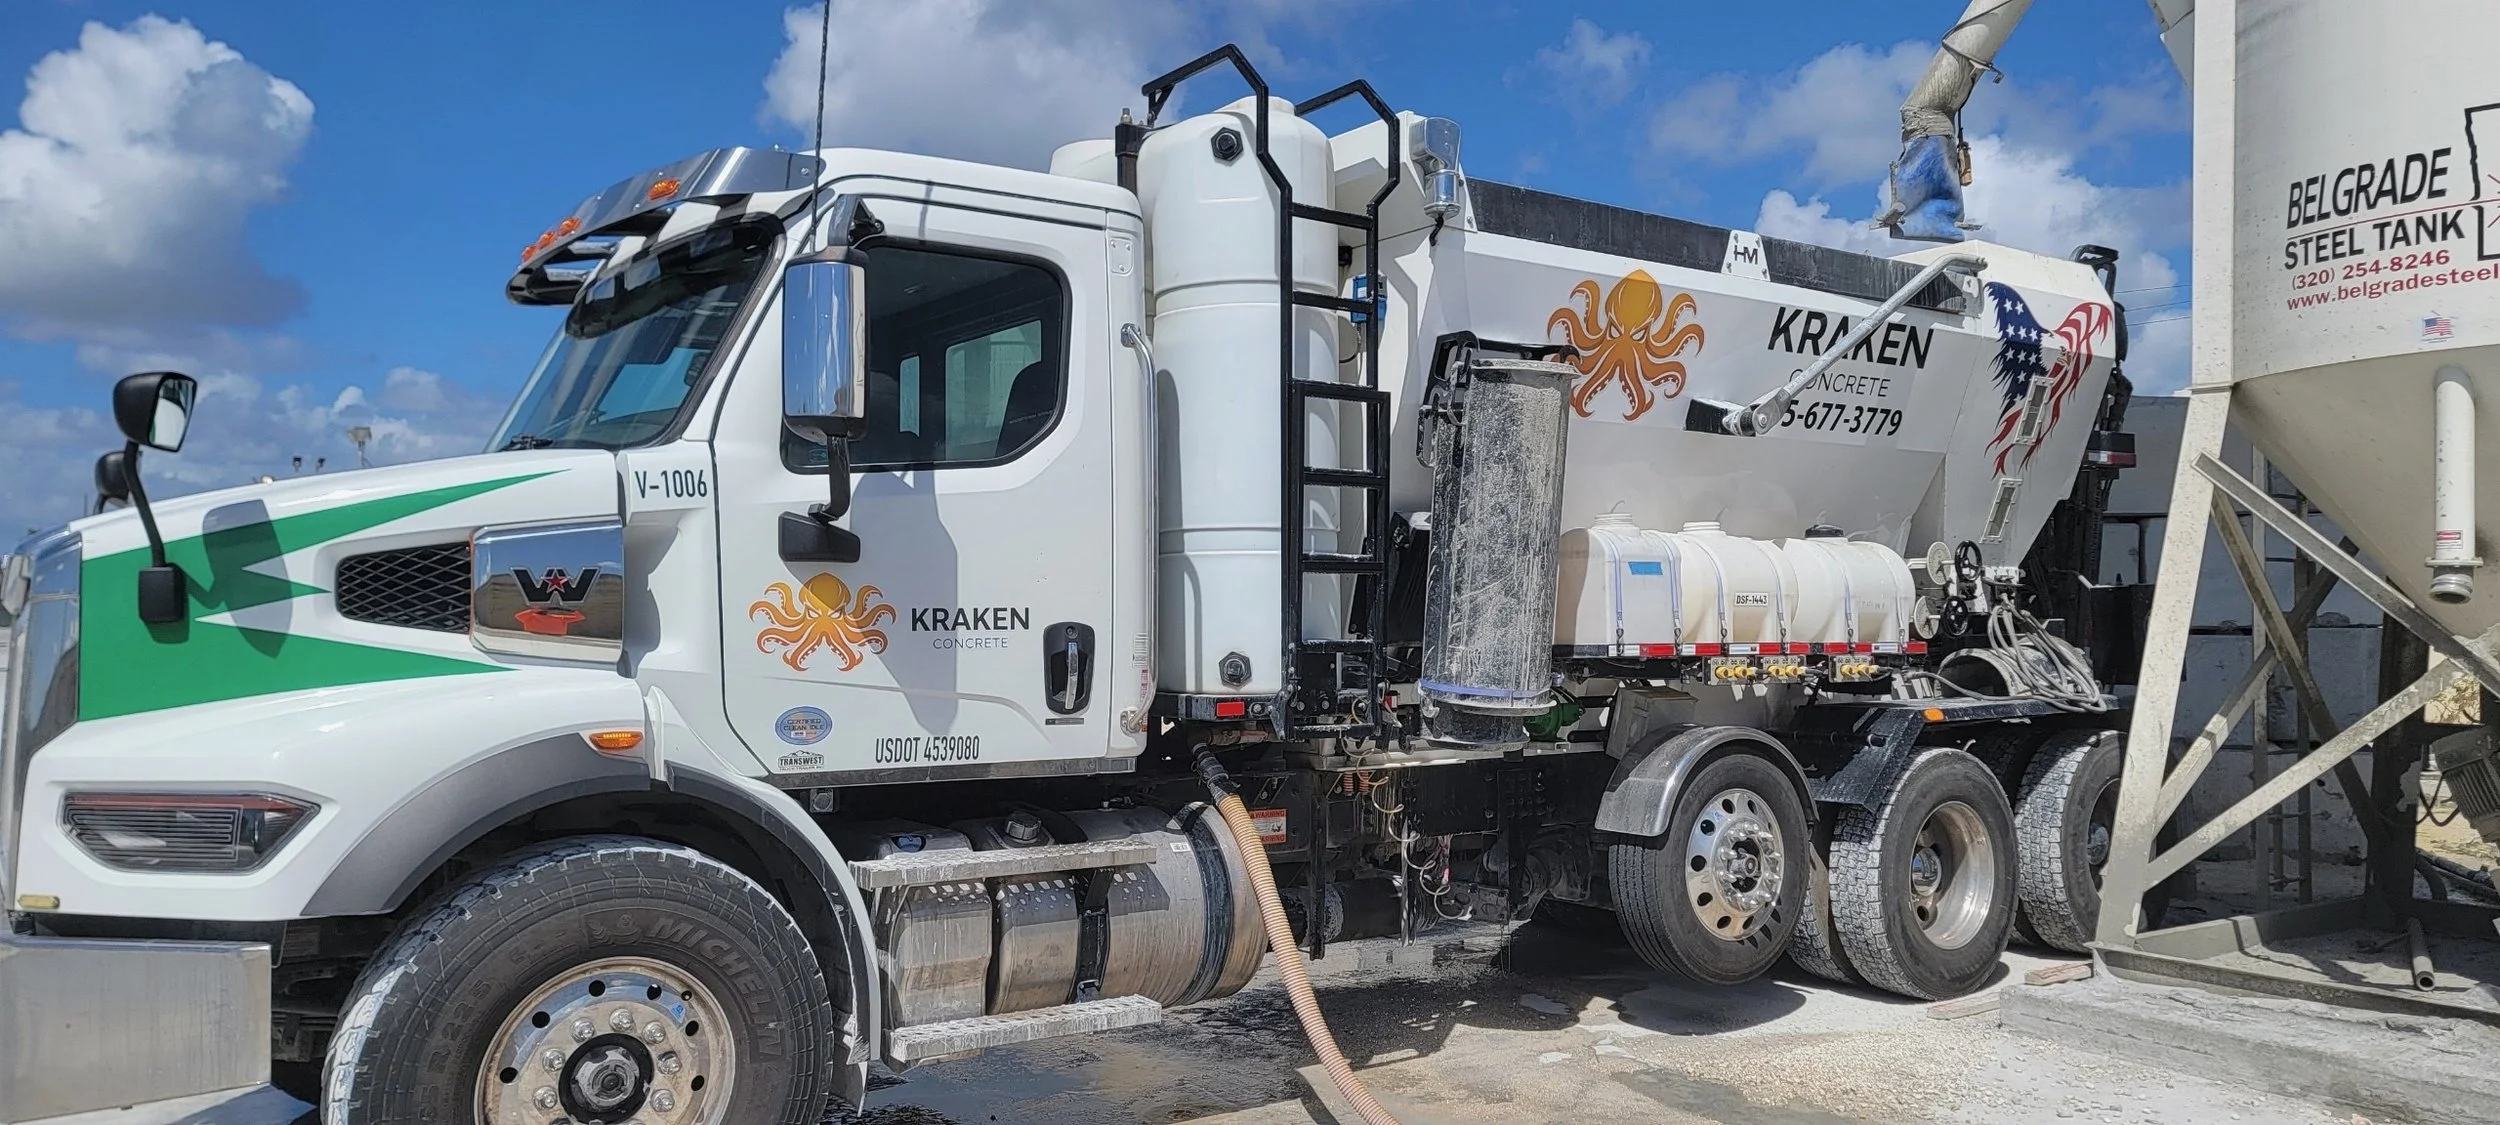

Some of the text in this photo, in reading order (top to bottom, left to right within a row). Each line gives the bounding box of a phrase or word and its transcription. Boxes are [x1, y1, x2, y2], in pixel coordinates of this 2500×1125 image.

[2287, 147, 2452, 229] BELGRADE
[2284, 209, 2465, 270] STEEL TANK
[2291, 249, 2450, 291] (320) 254-8246
[2287, 263, 2499, 311] www.belgradesteel
[1781, 400, 1902, 436] 5-677-3779
[635, 469, 707, 498] V-1006
[1736, 595, 1767, 605] DSF-1443
[911, 607, 1029, 632] KRAKEN
[933, 637, 1008, 649] CONCRETE
[780, 756, 822, 766] TRANSWEST
[875, 735, 980, 763] USDOT 4539080
[650, 916, 783, 1056] MICHELIN
